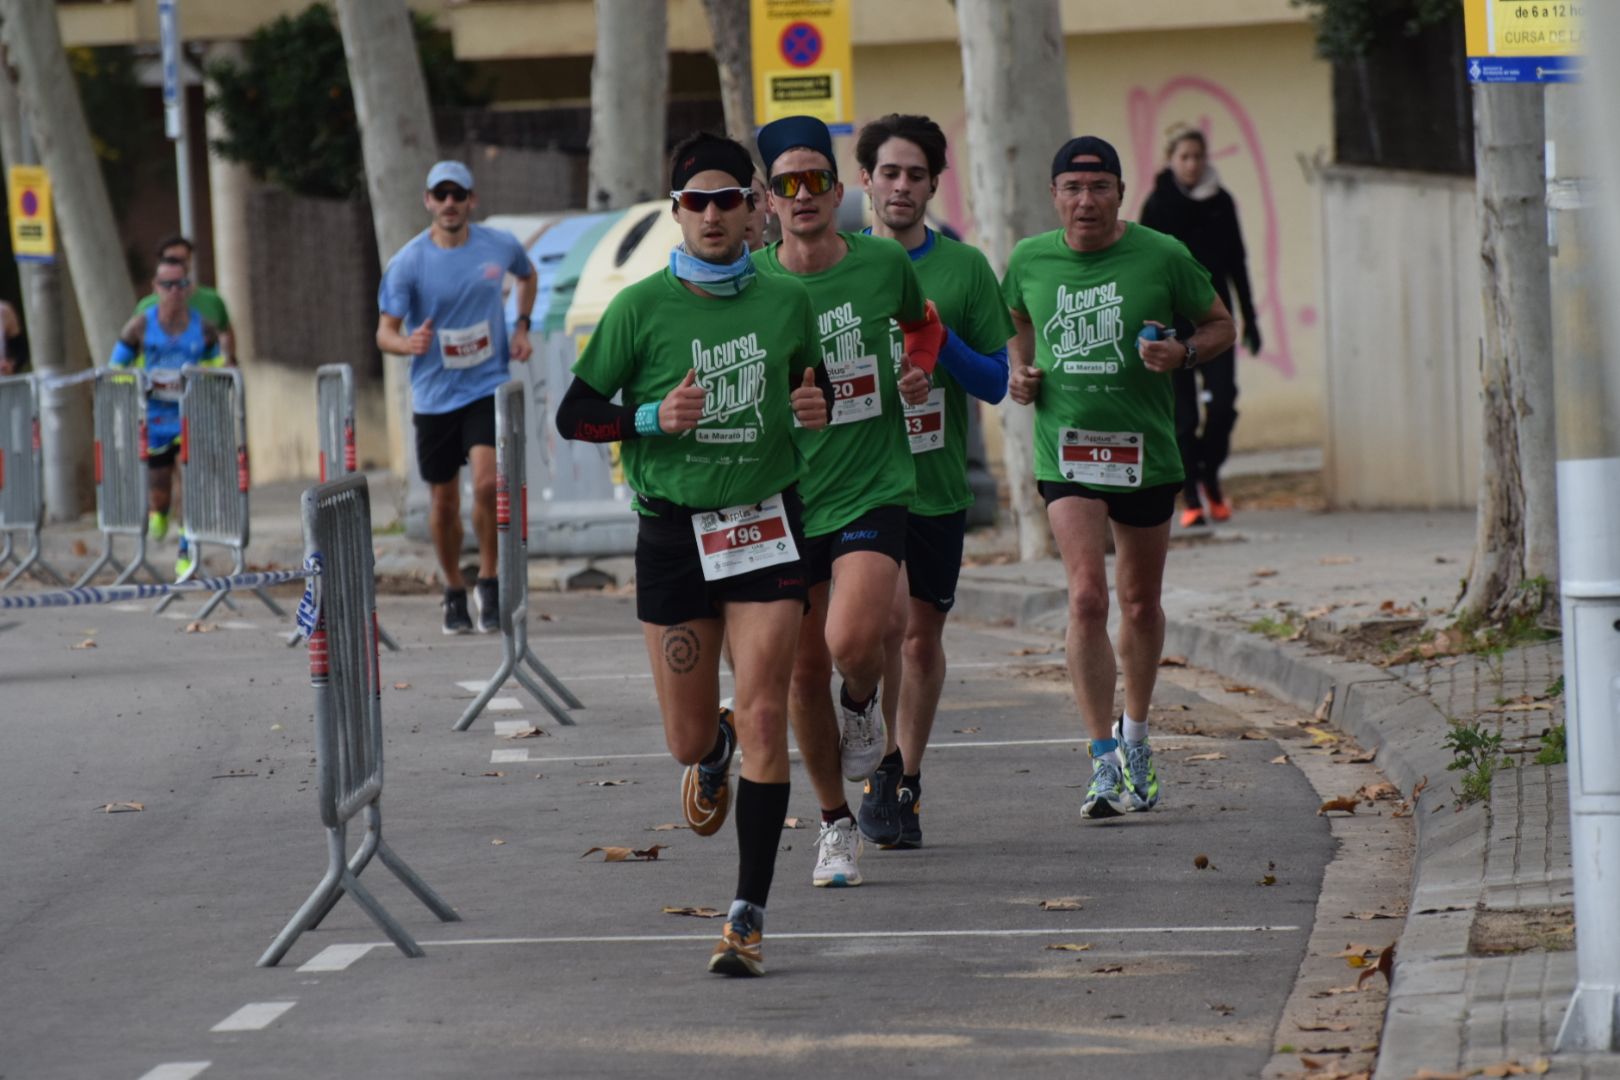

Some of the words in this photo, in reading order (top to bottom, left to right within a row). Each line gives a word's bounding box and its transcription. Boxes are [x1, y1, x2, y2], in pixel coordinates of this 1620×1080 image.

[1515, 7, 1529, 18] de
[1531, 6, 1539, 18] 6
[1542, 8, 1549, 17] a
[1553, 6, 1566, 17] 12
[1504, 30, 1545, 44] CURSA
[1549, 30, 1566, 43] DE
[697, 431, 709, 440] La
[1088, 448, 1112, 462] 10
[726, 525, 762, 546] 196
